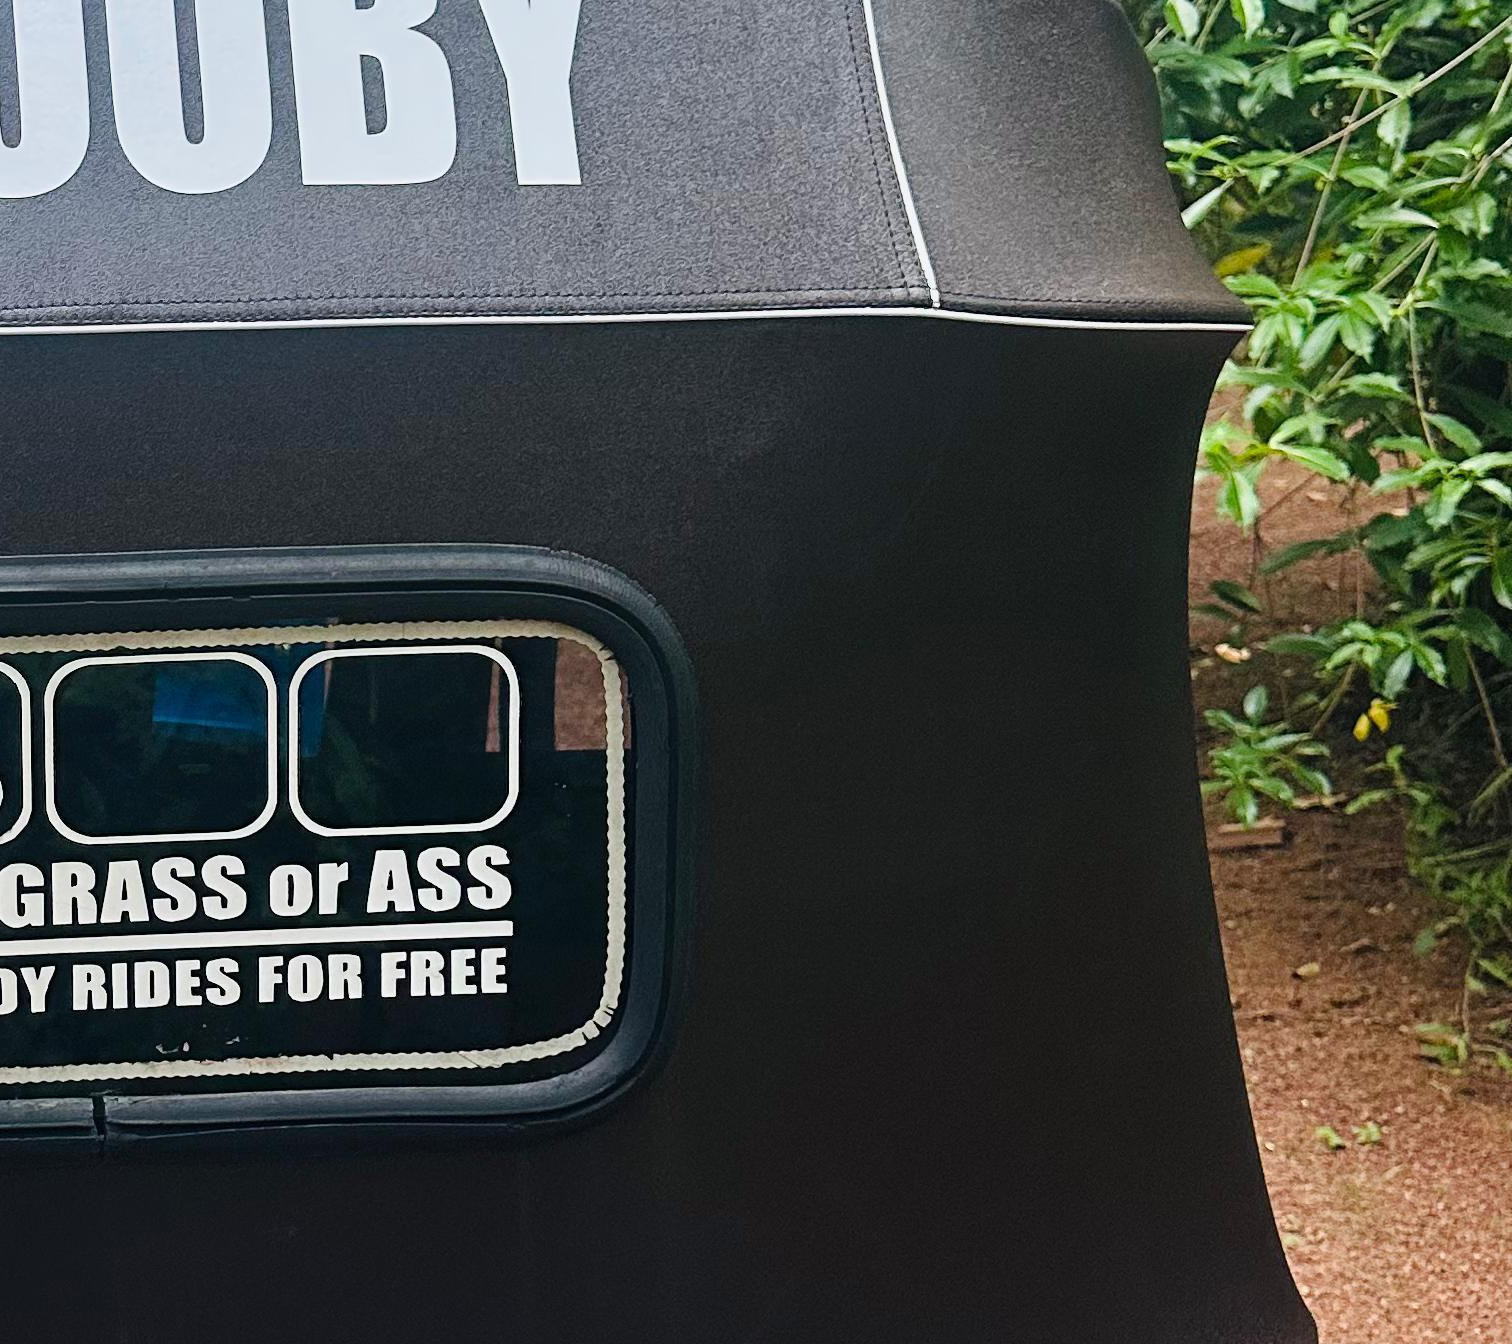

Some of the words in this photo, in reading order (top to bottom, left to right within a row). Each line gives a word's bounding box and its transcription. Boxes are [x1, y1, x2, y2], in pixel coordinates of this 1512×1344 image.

[269, 861, 349, 917] or
[366, 844, 512, 914] ASS
[72, 957, 241, 1011] RIDES
[258, 953, 363, 1004] FOR
[380, 947, 508, 998] FREE
